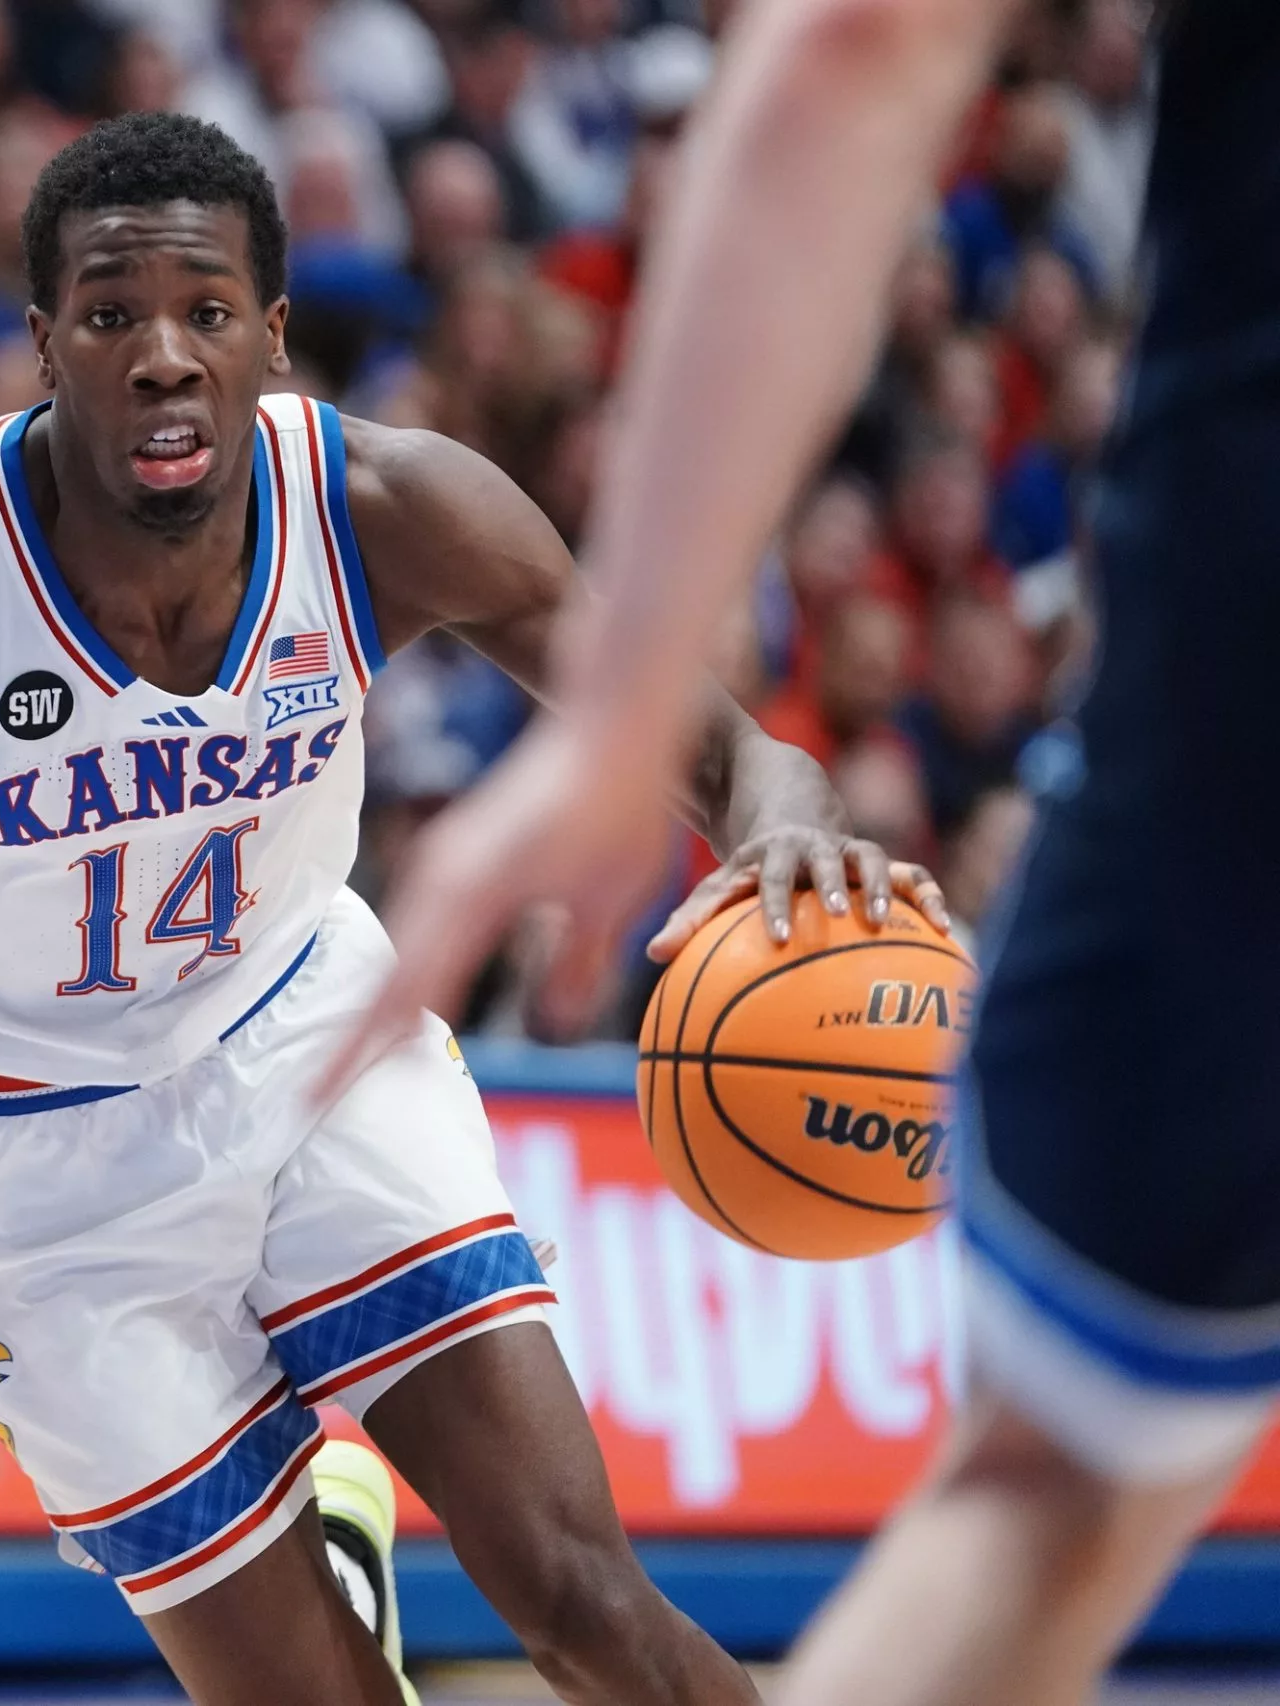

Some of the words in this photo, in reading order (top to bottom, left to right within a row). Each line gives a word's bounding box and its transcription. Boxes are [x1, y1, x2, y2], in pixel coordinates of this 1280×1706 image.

[8, 687, 62, 727] SW
[57, 816, 262, 997] 14
[813, 1011, 863, 1031] NXT
[802, 1096, 952, 1181] ilson
